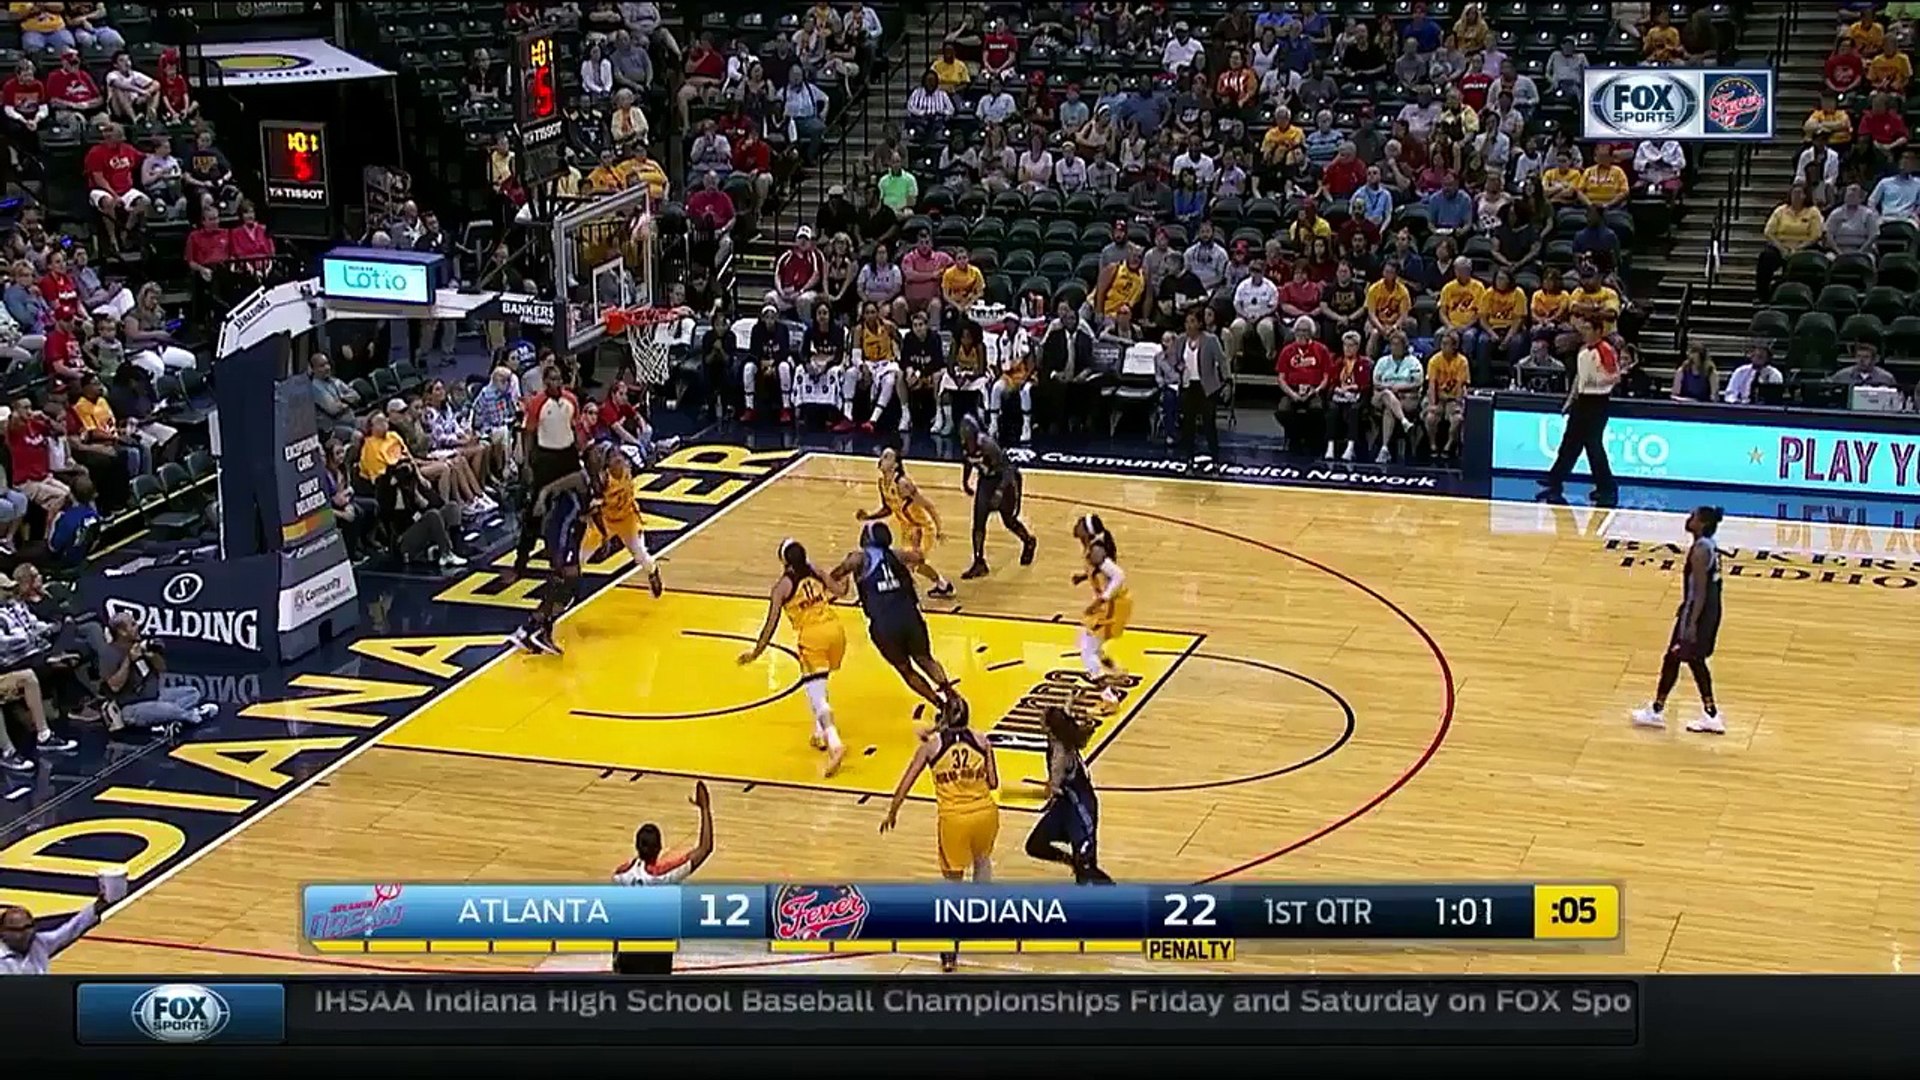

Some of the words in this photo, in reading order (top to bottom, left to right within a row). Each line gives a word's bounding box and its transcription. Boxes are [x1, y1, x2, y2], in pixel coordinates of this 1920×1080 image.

[284, 188, 324, 200] TISSOT
[502, 302, 554, 319] BANKERS
[1041, 451, 1188, 472] Community
[1306, 467, 1436, 488] Network
[1780, 436, 1878, 484] PLAY
[1890, 442, 1920, 487] Y
[951, 747, 970, 769] 32
